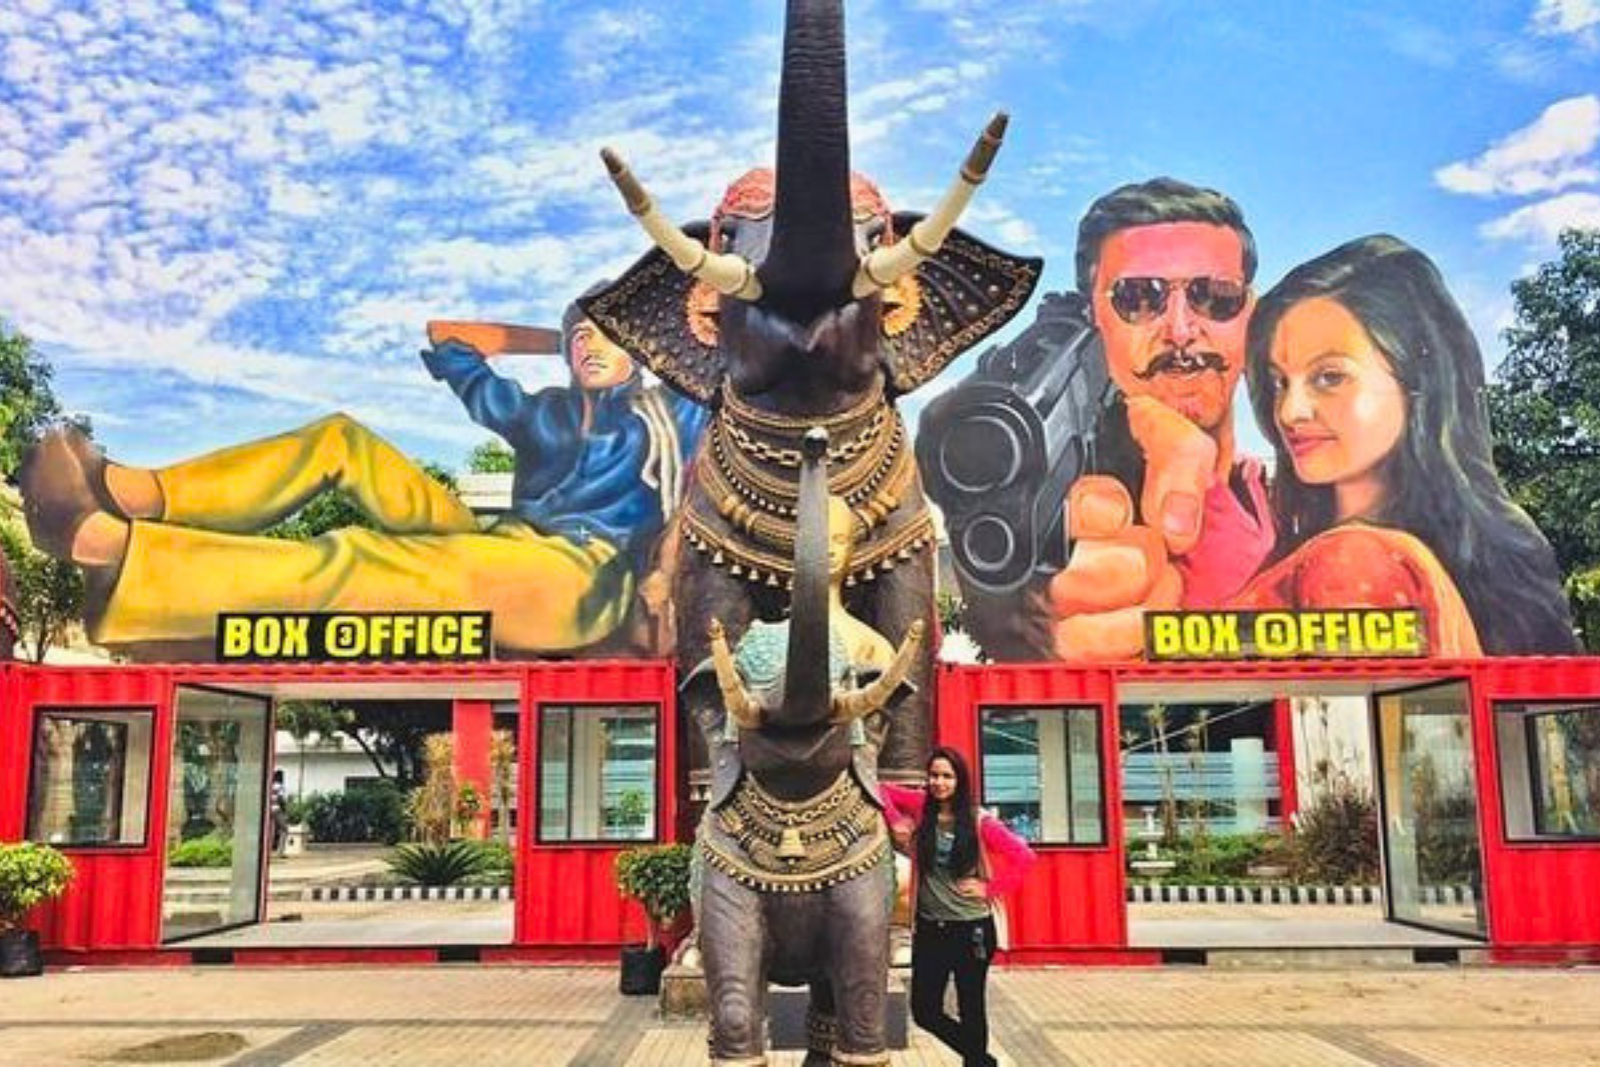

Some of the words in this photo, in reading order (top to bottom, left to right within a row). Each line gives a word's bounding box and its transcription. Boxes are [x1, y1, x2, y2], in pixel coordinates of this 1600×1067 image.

[223, 616, 310, 657] BOX
[324, 615, 484, 658] OFFICE
[1153, 614, 1240, 655] BOX
[1254, 611, 1419, 656] OFFICE
